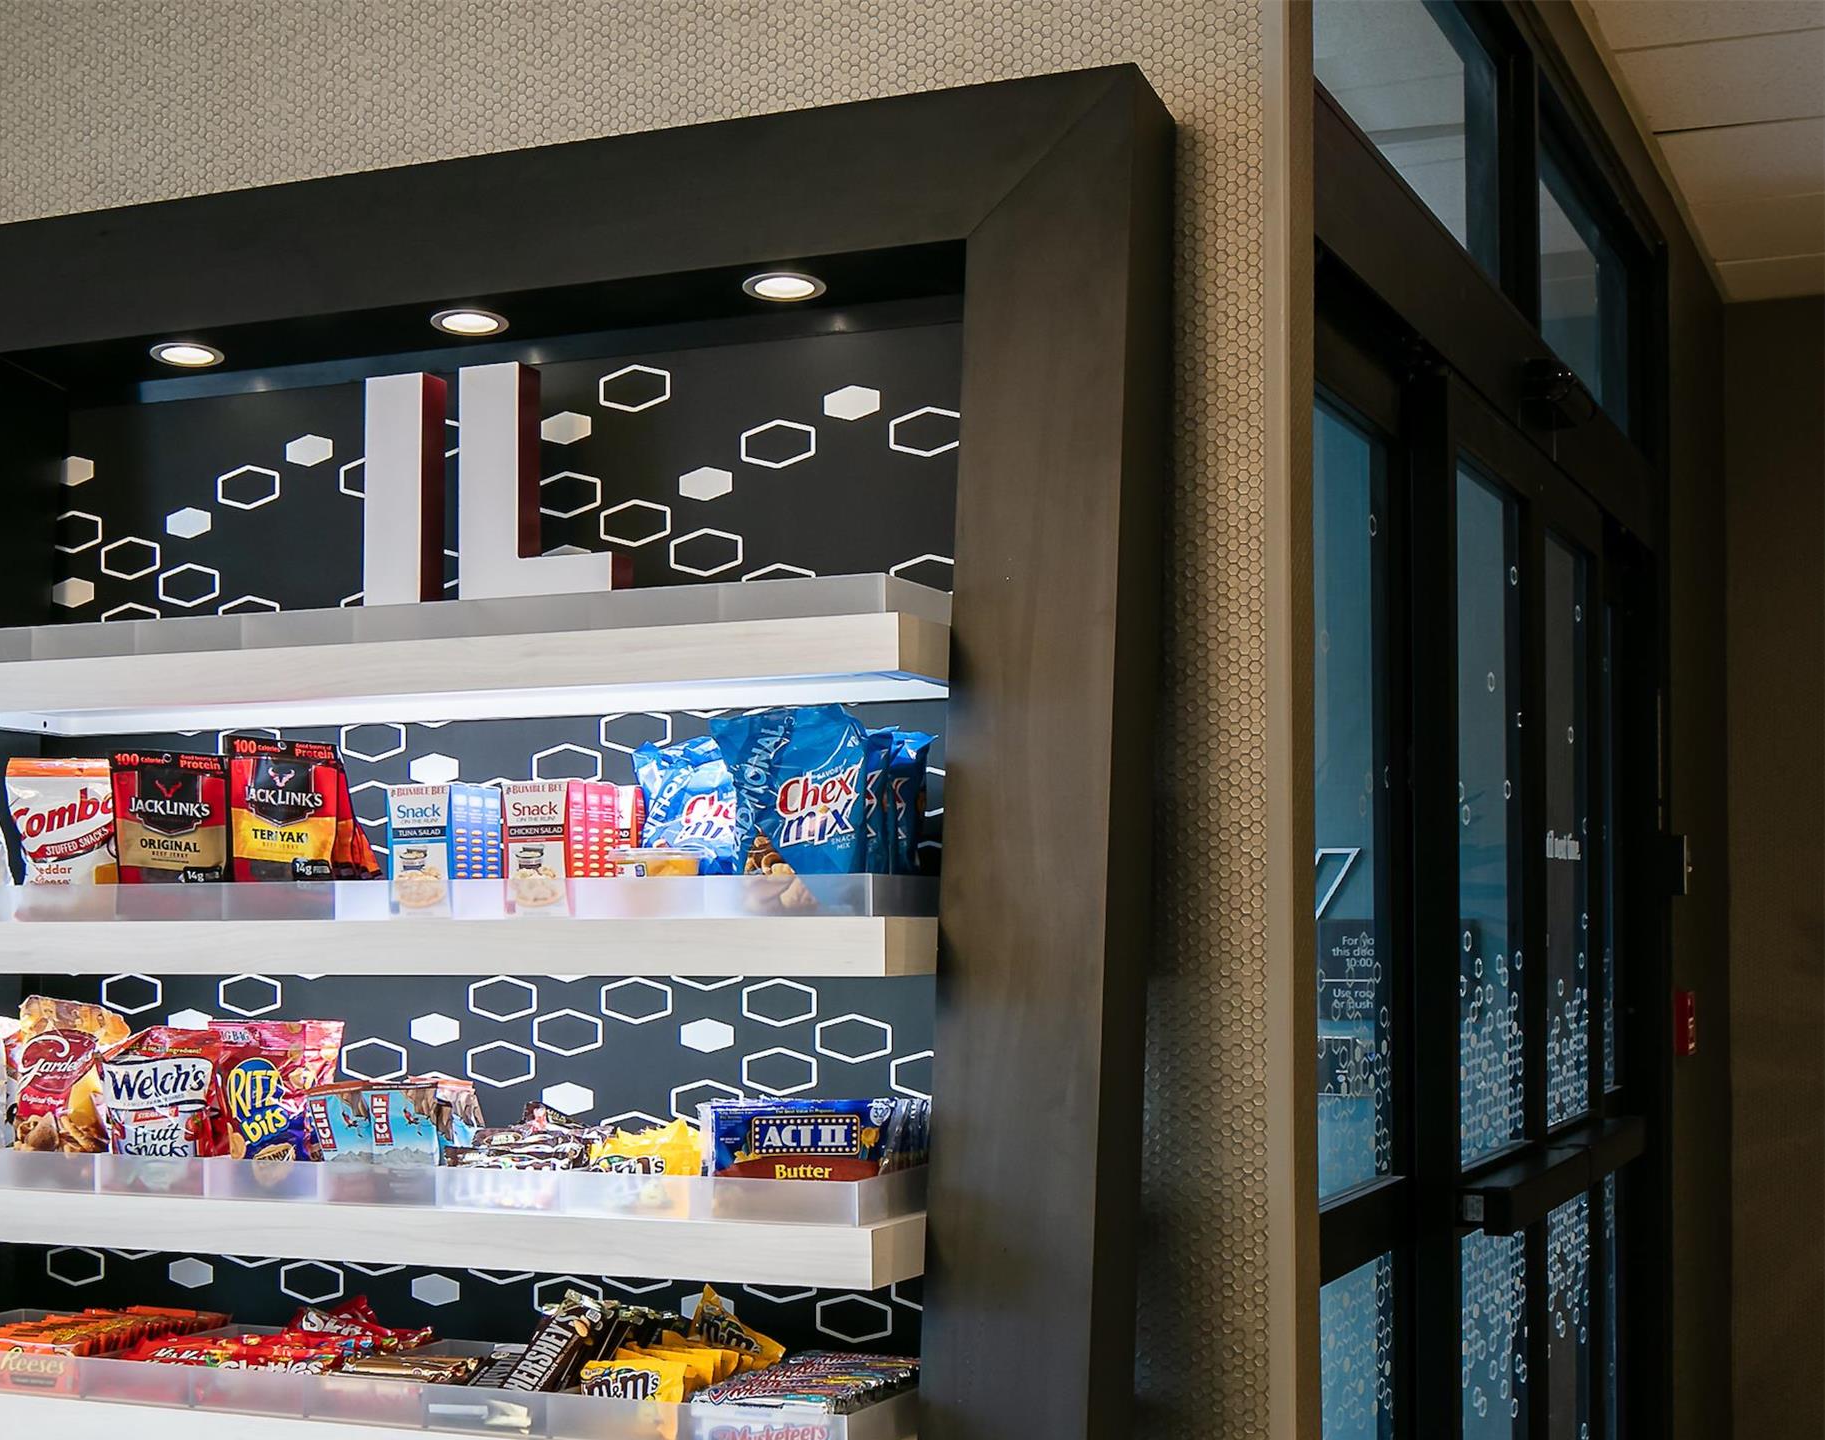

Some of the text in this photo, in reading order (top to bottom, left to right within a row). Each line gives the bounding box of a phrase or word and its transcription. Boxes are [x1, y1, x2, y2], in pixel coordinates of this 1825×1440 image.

[233, 739, 257, 754] 100
[115, 753, 140, 766] 100
[295, 749, 335, 760] Protein
[180, 760, 221, 770] Protein
[245, 786, 323, 808] JACK LINK'S
[776, 764, 860, 817] Chex
[129, 797, 211, 818] JACK LINK'S
[396, 803, 441, 819] Snack
[512, 801, 558, 817] Snack
[418, 829, 441, 837] SALAD
[509, 826, 563, 836] CHICKEN SALAD
[45, 827, 110, 856] STUFFED SNACKS
[139, 838, 201, 853] ORIGINAL
[830, 834, 856, 845] SNACK
[187, 870, 205, 882] 14g
[296, 862, 313, 876] 14g
[1342, 936, 1358, 946] For
[1332, 947, 1350, 957] this
[1345, 958, 1373, 968] 10:00
[1333, 988, 1351, 998] Use
[107, 1063, 206, 1101] Welch's
[227, 1066, 286, 1121] RITZ
[242, 1106, 289, 1143] bits
[135, 1123, 181, 1146] Fruit
[762, 1124, 814, 1147] ACT
[818, 1124, 848, 1147] II
[775, 1163, 833, 1179] Butter
[507, 1314, 579, 1391] HERSHEY'S
